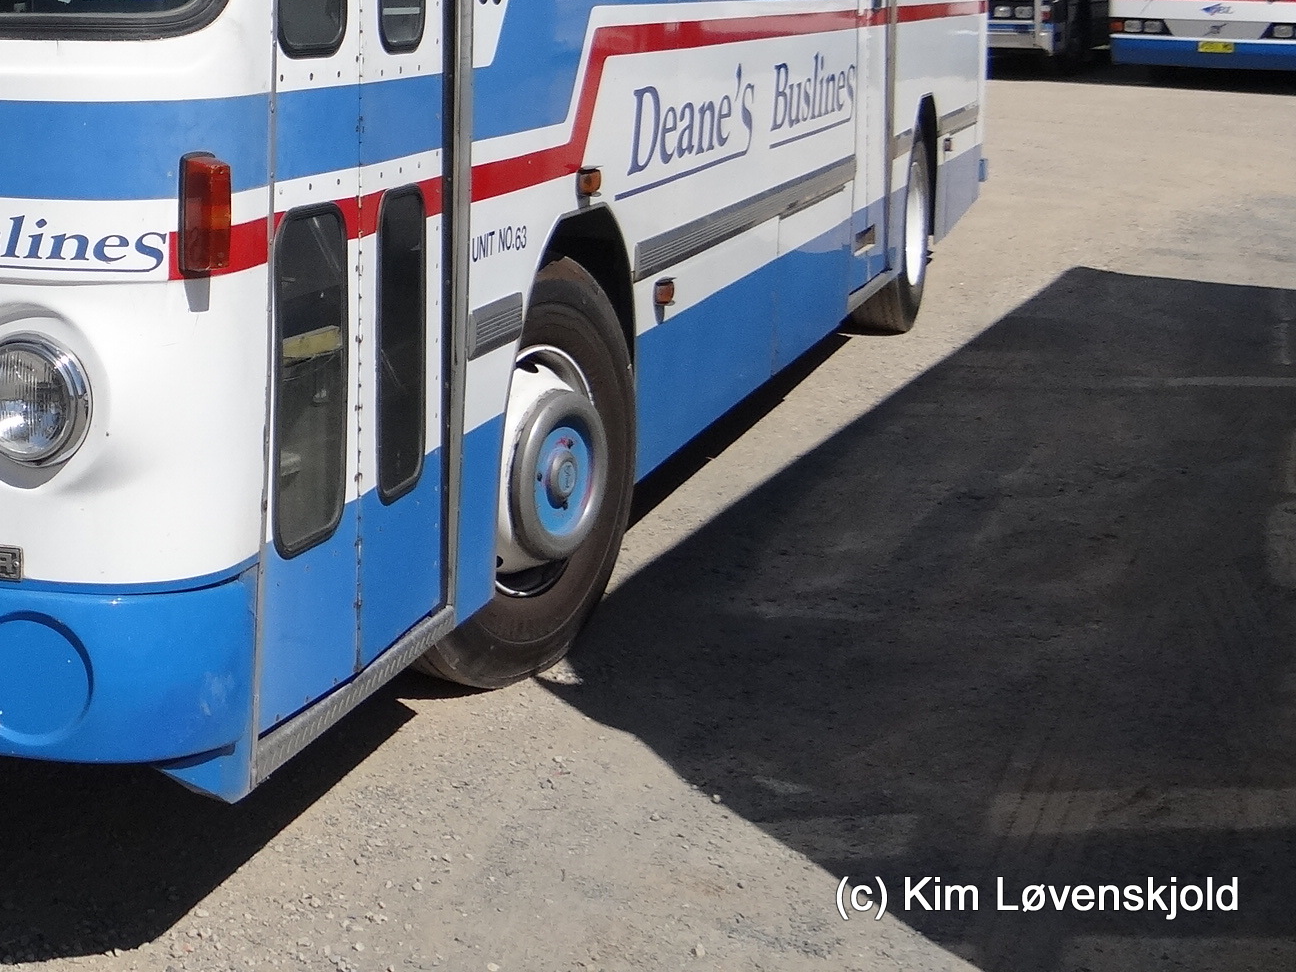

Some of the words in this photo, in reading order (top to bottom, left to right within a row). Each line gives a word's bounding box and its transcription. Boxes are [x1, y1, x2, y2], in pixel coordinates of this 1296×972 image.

[626, 62, 756, 177] Deane's
[770, 51, 857, 132] Buslines
[472, 231, 495, 262] UNIT
